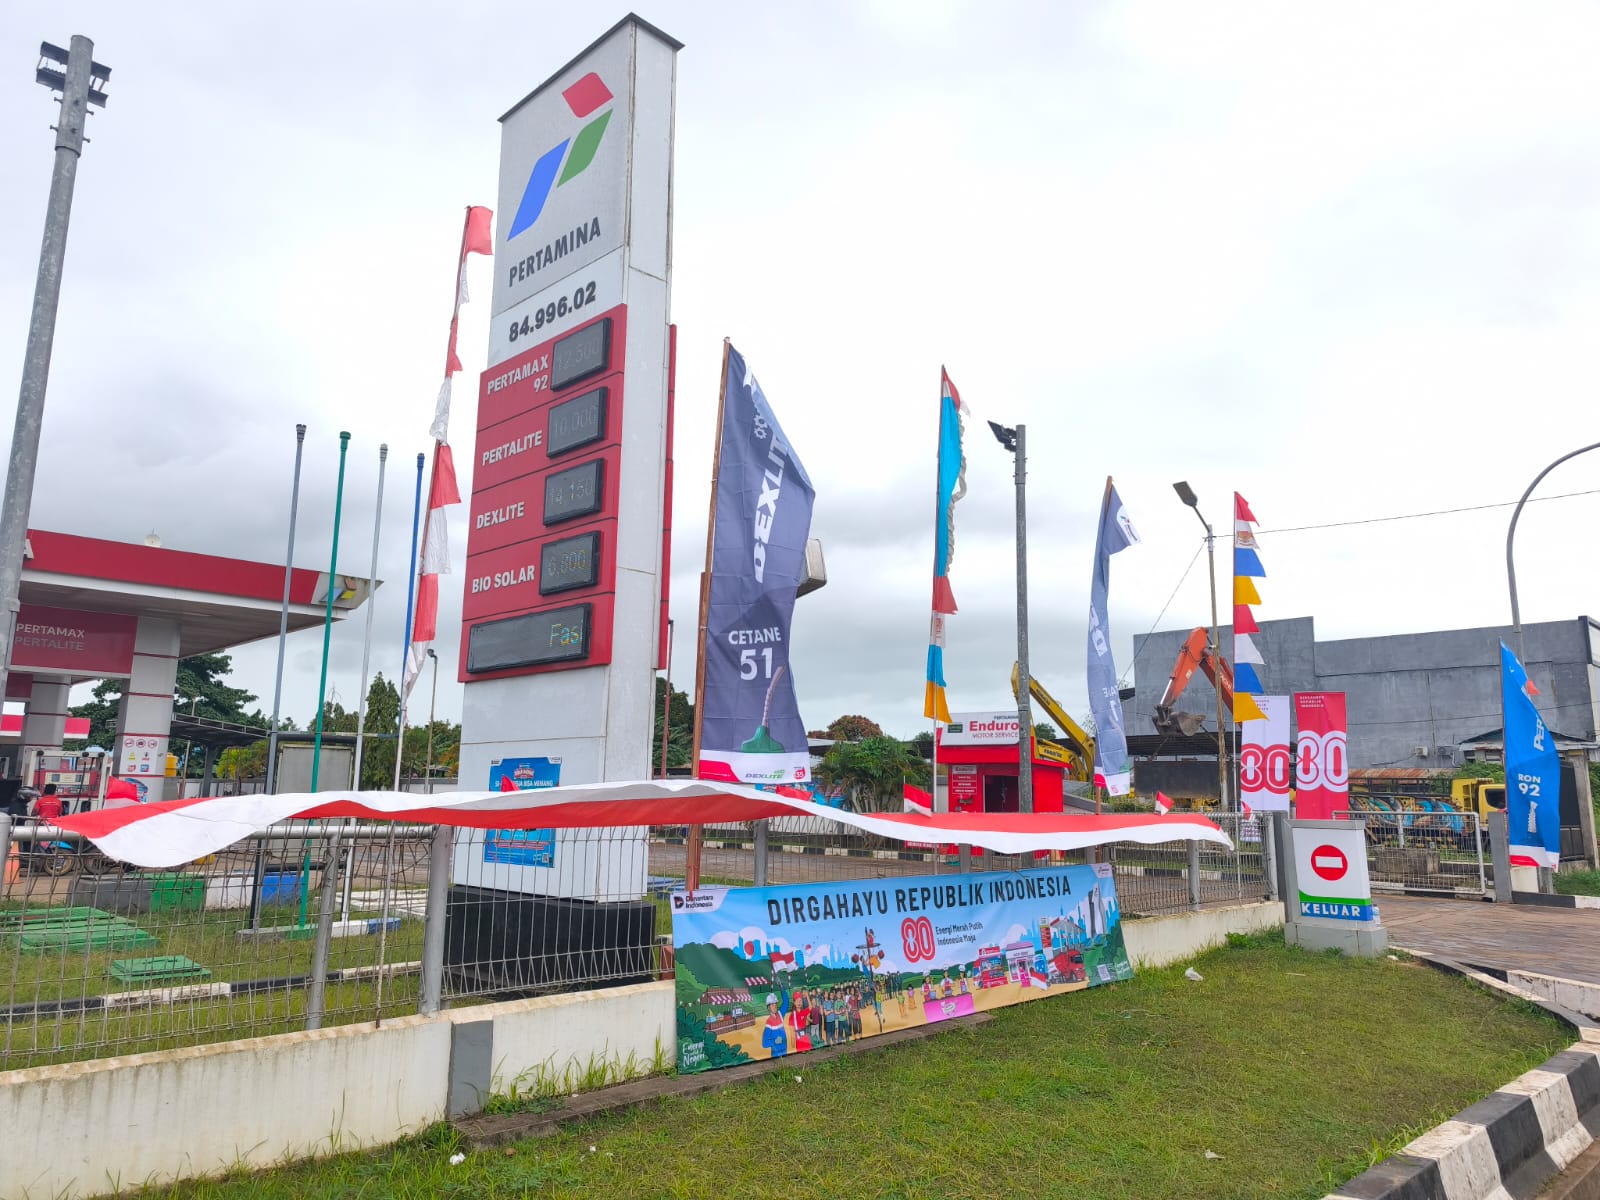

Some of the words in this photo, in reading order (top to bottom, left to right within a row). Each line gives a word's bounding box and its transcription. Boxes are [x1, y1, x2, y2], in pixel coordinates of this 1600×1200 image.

[508, 216, 601, 288] PERTAMINA
[508, 280, 597, 342] 84.996.02
[487, 354, 550, 395] PERTAMAX
[533, 375, 549, 393] 92
[482, 430, 543, 466] PERTALITE
[476, 502, 525, 530] DEXLITE
[472, 575, 491, 594] BIO
[493, 565, 535, 588] SOLAR
[15, 623, 85, 638] PERTAMAX
[15, 636, 85, 650] PERTALITE
[728, 627, 782, 645] CETANE
[740, 648, 773, 681] 51
[969, 720, 1019, 732] Enduro
[1240, 743, 1290, 794] 80
[1296, 730, 1349, 793] 80
[1518, 773, 1541, 784] RON
[1518, 783, 1541, 797] 92
[767, 889, 888, 926] DIRGAHAYU
[895, 883, 984, 913] REPUBLIK
[989, 875, 1071, 902] INDONESIA
[1301, 901, 1361, 918] KELUAR
[901, 915, 936, 963] 80
[935, 925, 952, 935] Energi
[952, 924, 968, 932] Merah
[937, 935, 963, 945] Indonesia
